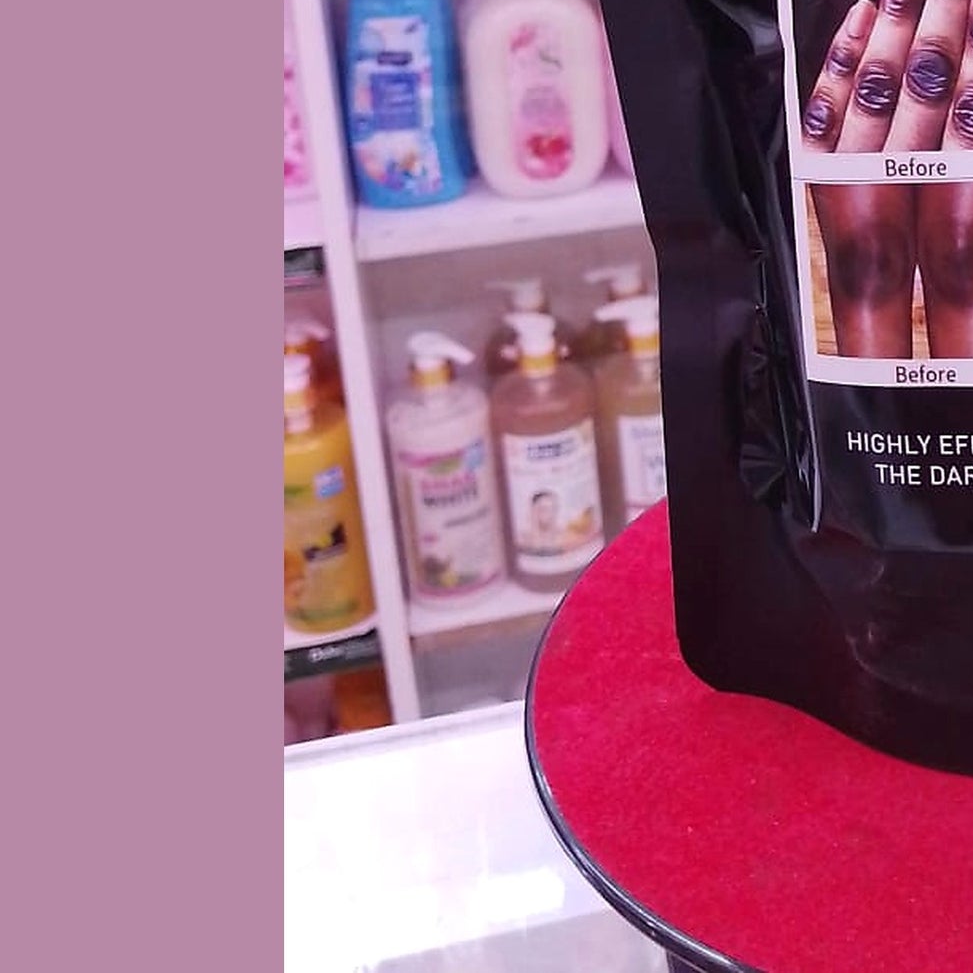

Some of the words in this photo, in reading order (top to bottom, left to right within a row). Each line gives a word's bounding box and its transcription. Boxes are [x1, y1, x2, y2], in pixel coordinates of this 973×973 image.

[885, 158, 947, 177] Before
[895, 365, 957, 384] Before
[847, 430, 931, 456] HIGHLY
[874, 463, 922, 486] THE
